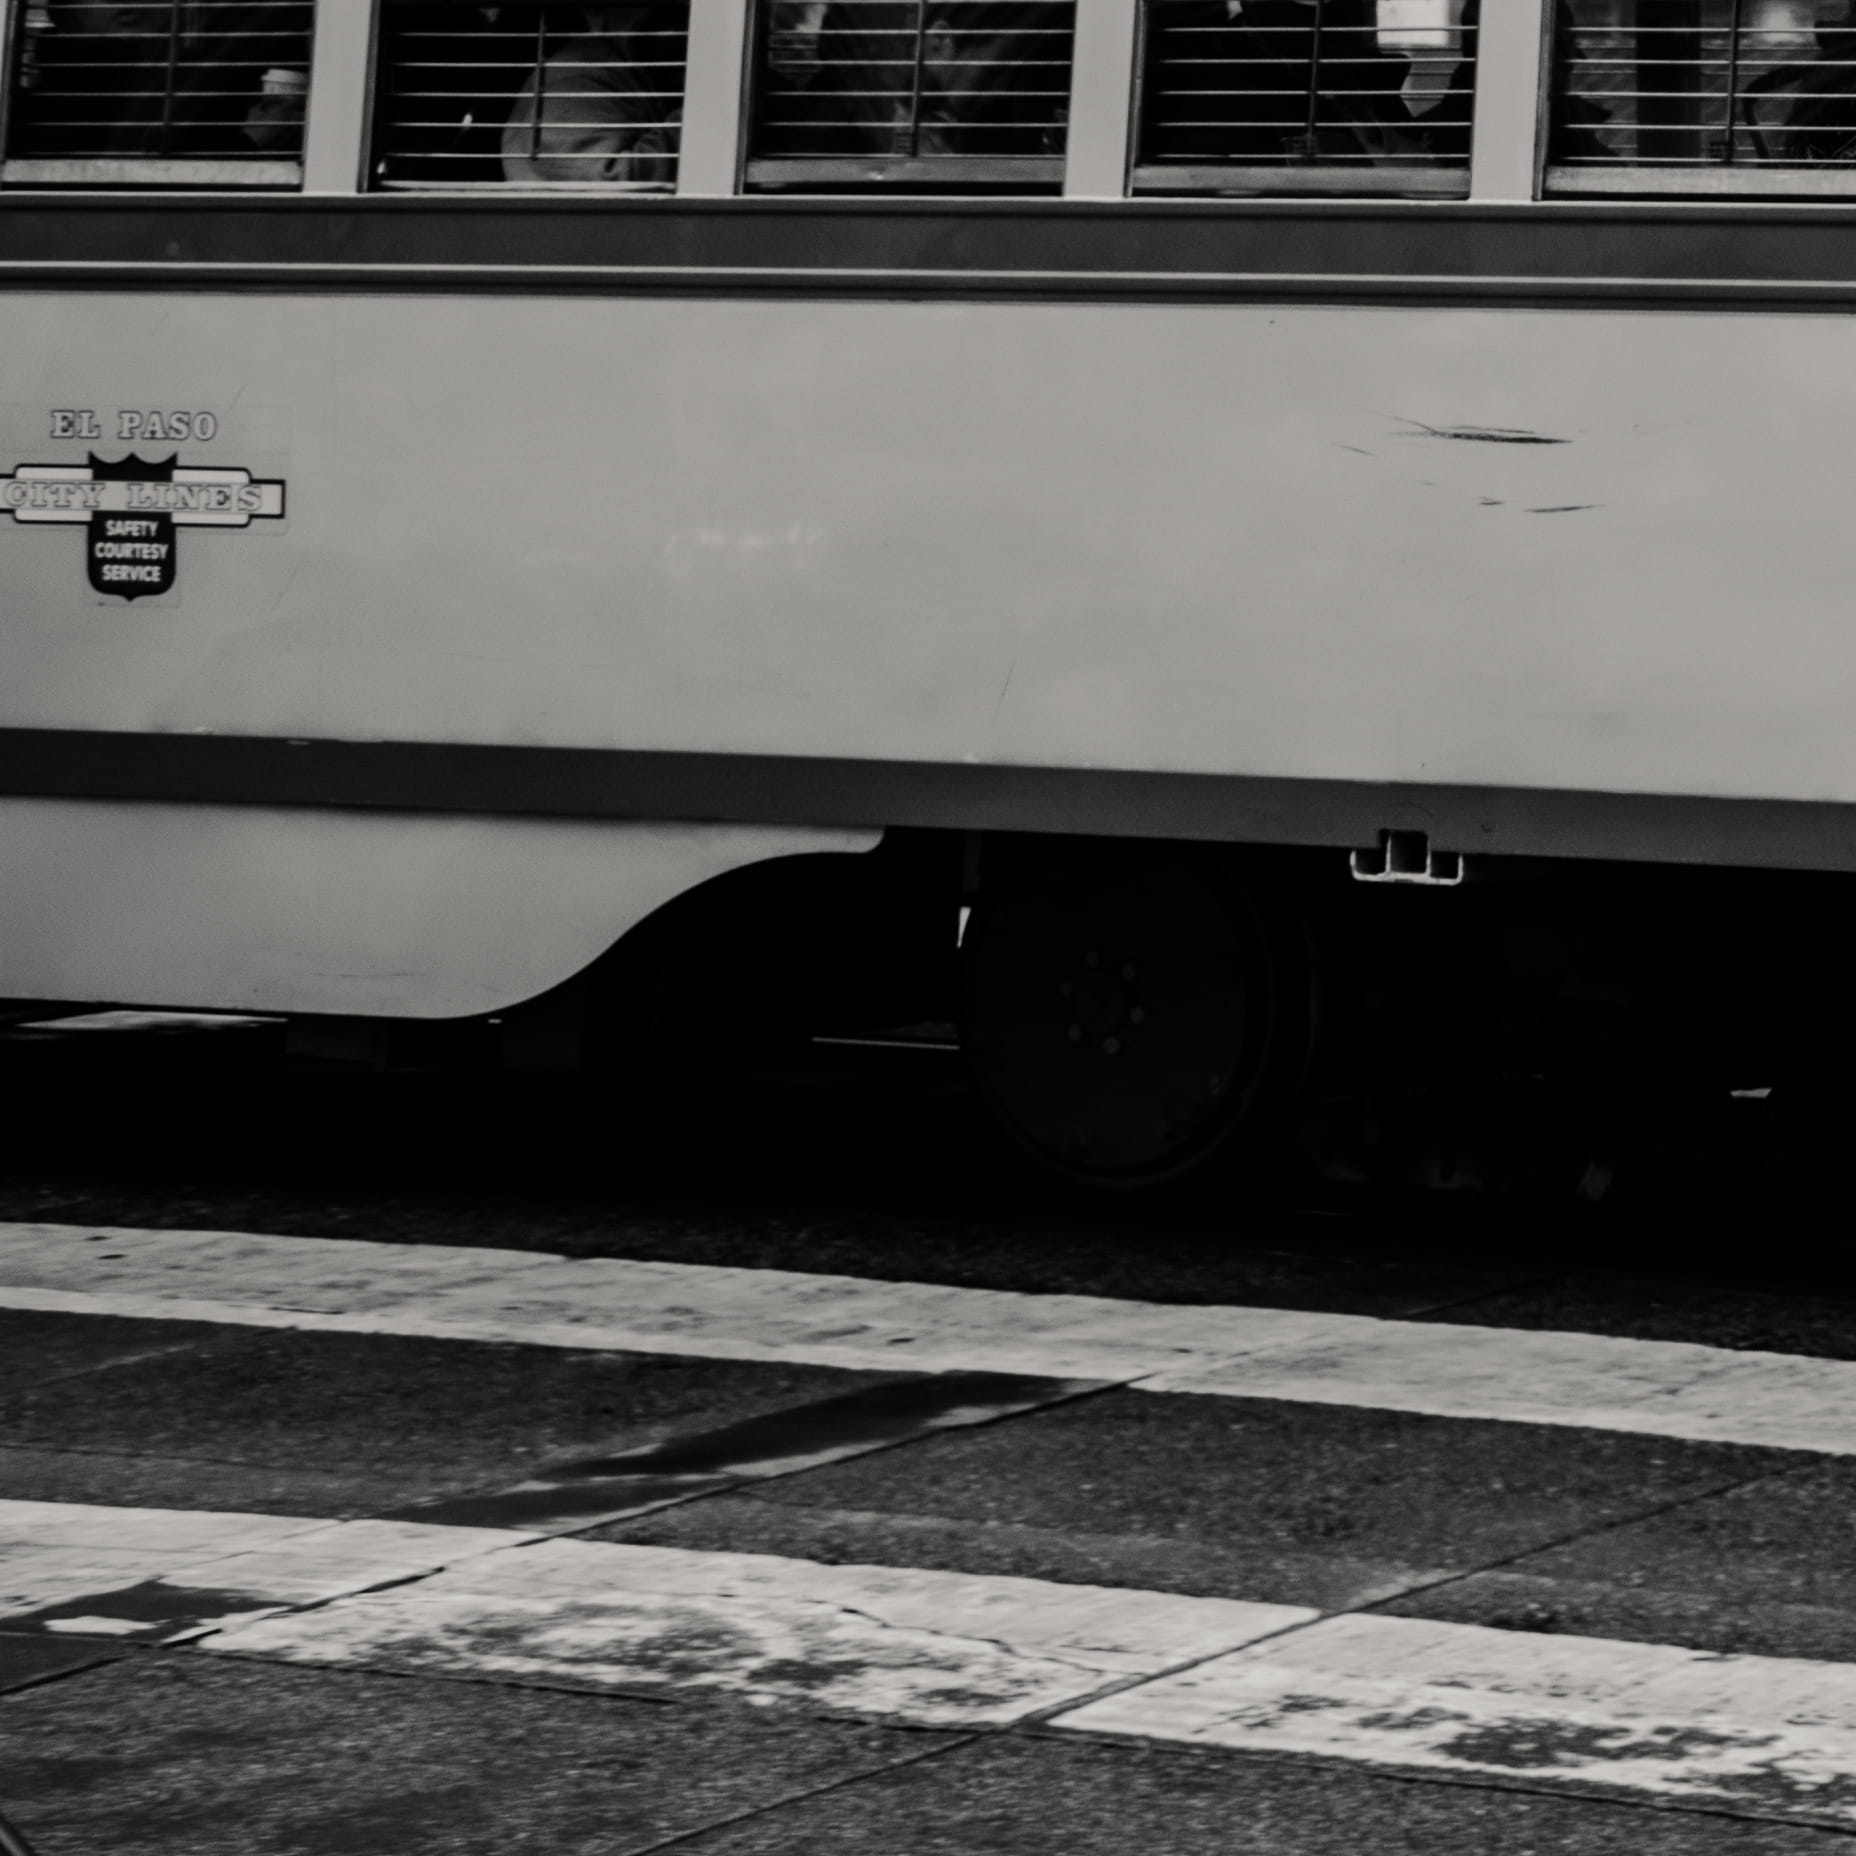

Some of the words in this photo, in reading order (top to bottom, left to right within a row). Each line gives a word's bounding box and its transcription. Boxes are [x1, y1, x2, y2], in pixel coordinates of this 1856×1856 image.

[50, 409, 101, 439] EL
[117, 410, 218, 441] PASO
[3, 481, 105, 509] CITY
[127, 482, 263, 512] LINES
[105, 519, 159, 538] SAFETY
[94, 543, 169, 560] COURTESY
[102, 564, 161, 583] SERVICE
